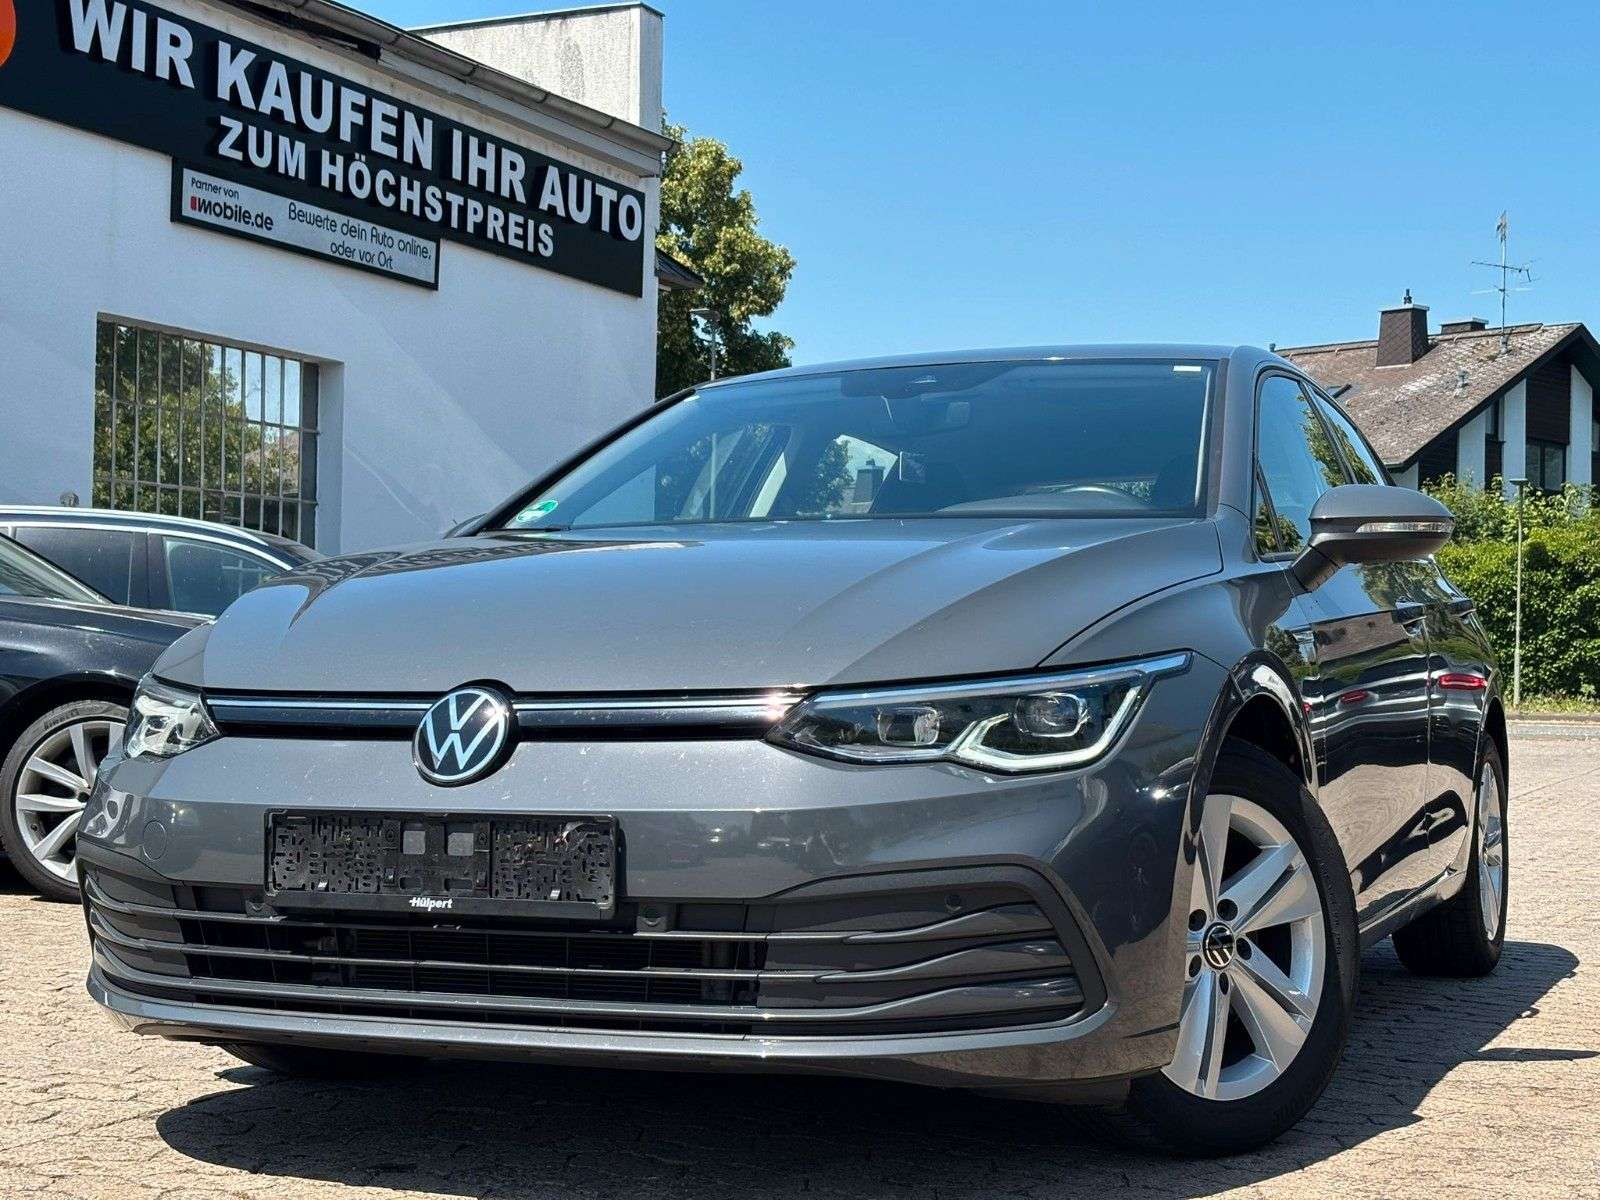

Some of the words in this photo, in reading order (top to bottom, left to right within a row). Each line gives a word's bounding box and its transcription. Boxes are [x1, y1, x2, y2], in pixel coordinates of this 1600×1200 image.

[68, 0, 195, 89] WIR
[216, 39, 433, 171] KAUFEN
[451, 128, 526, 204] IHR
[539, 164, 643, 242] AUTO
[190, 176, 222, 194] Partner
[223, 187, 240, 199] von
[218, 115, 306, 180] ZUM
[321, 149, 554, 257] HÖCHSTPREIS
[288, 202, 337, 233] Bewerte
[340, 221, 367, 242] dein
[370, 226, 394, 249] Auto
[330, 242, 354, 260] oder
[358, 251, 375, 264] vor
[377, 250, 394, 270] Ort
[409, 896, 453, 912] Hülpert
